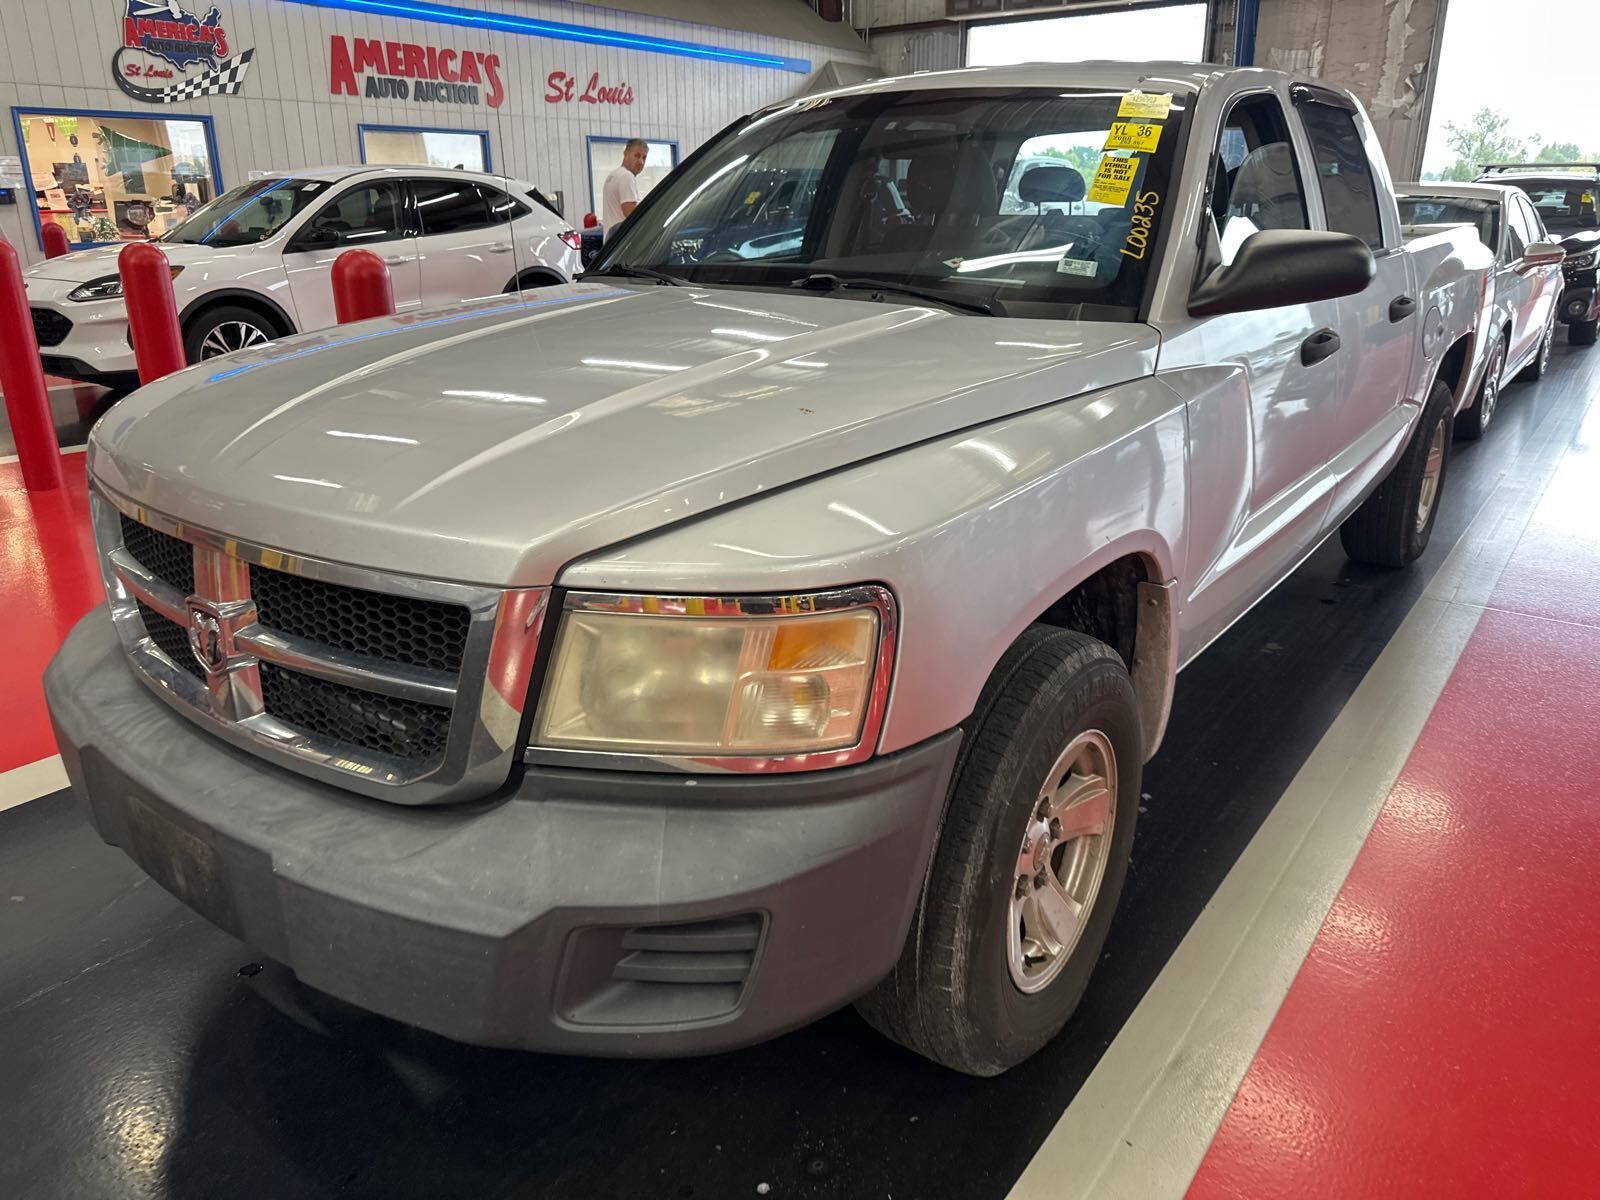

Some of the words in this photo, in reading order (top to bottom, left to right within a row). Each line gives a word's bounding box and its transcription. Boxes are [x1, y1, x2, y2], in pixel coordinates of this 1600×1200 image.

[125, 16, 228, 57] AMERICA'S
[126, 64, 141, 76] St
[143, 64, 173, 79] Louis
[330, 35, 504, 108] AMERICA'S
[365, 76, 409, 100] AUTO
[414, 80, 479, 106] AUCTION
[545, 71, 575, 104] St
[579, 72, 634, 106] Louis
[1114, 124, 1128, 136] YL
[1137, 126, 1153, 137] 36
